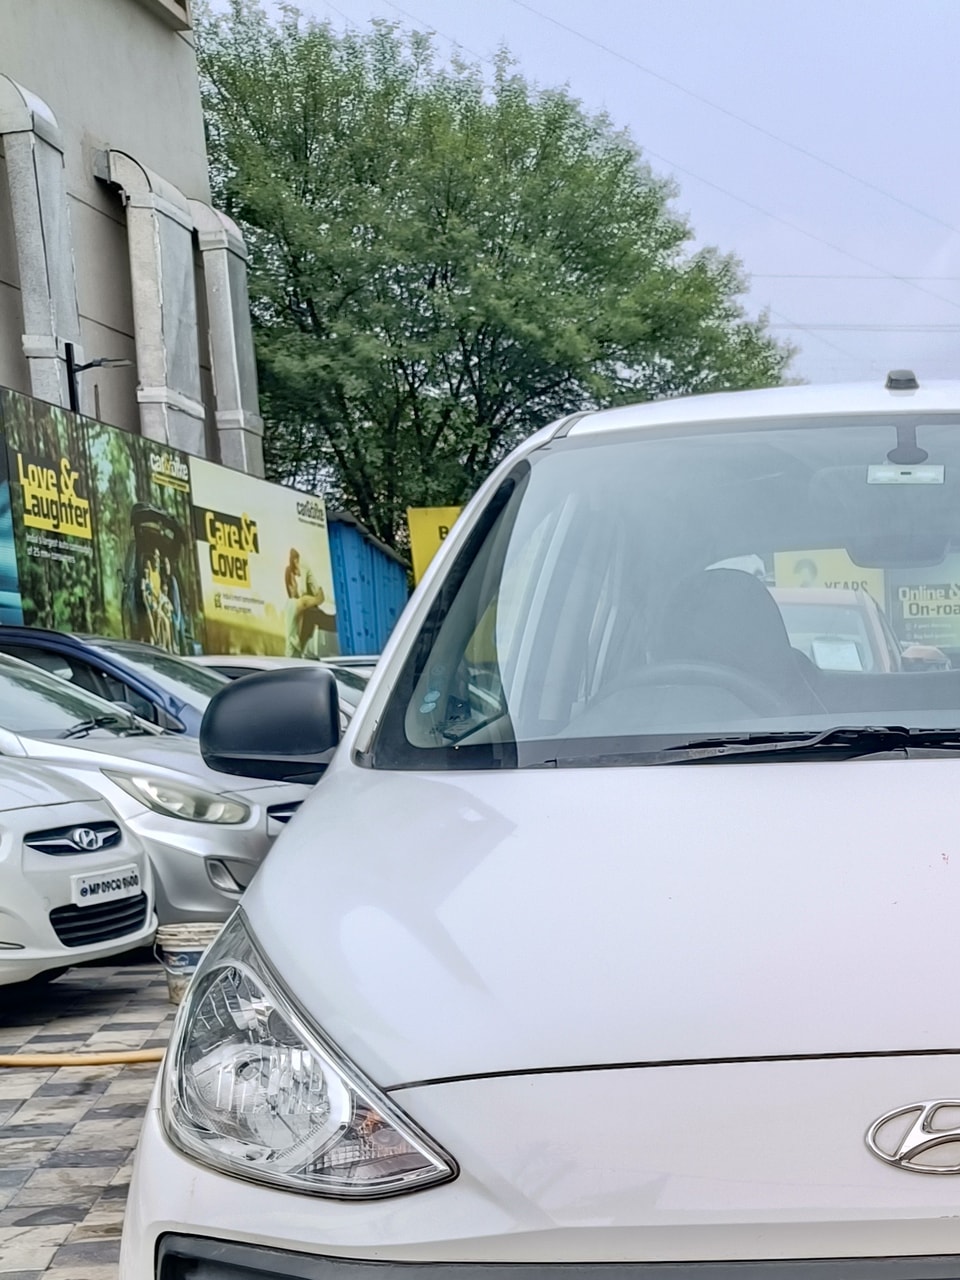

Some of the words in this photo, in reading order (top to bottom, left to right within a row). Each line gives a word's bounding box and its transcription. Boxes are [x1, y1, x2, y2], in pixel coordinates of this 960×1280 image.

[17, 453, 58, 492] Love
[60, 458, 79, 500] &
[23, 485, 89, 530] Laughter
[205, 511, 240, 550] Care
[241, 511, 257, 552] &
[209, 543, 249, 581] Cover
[898, 585, 946, 601] Online
